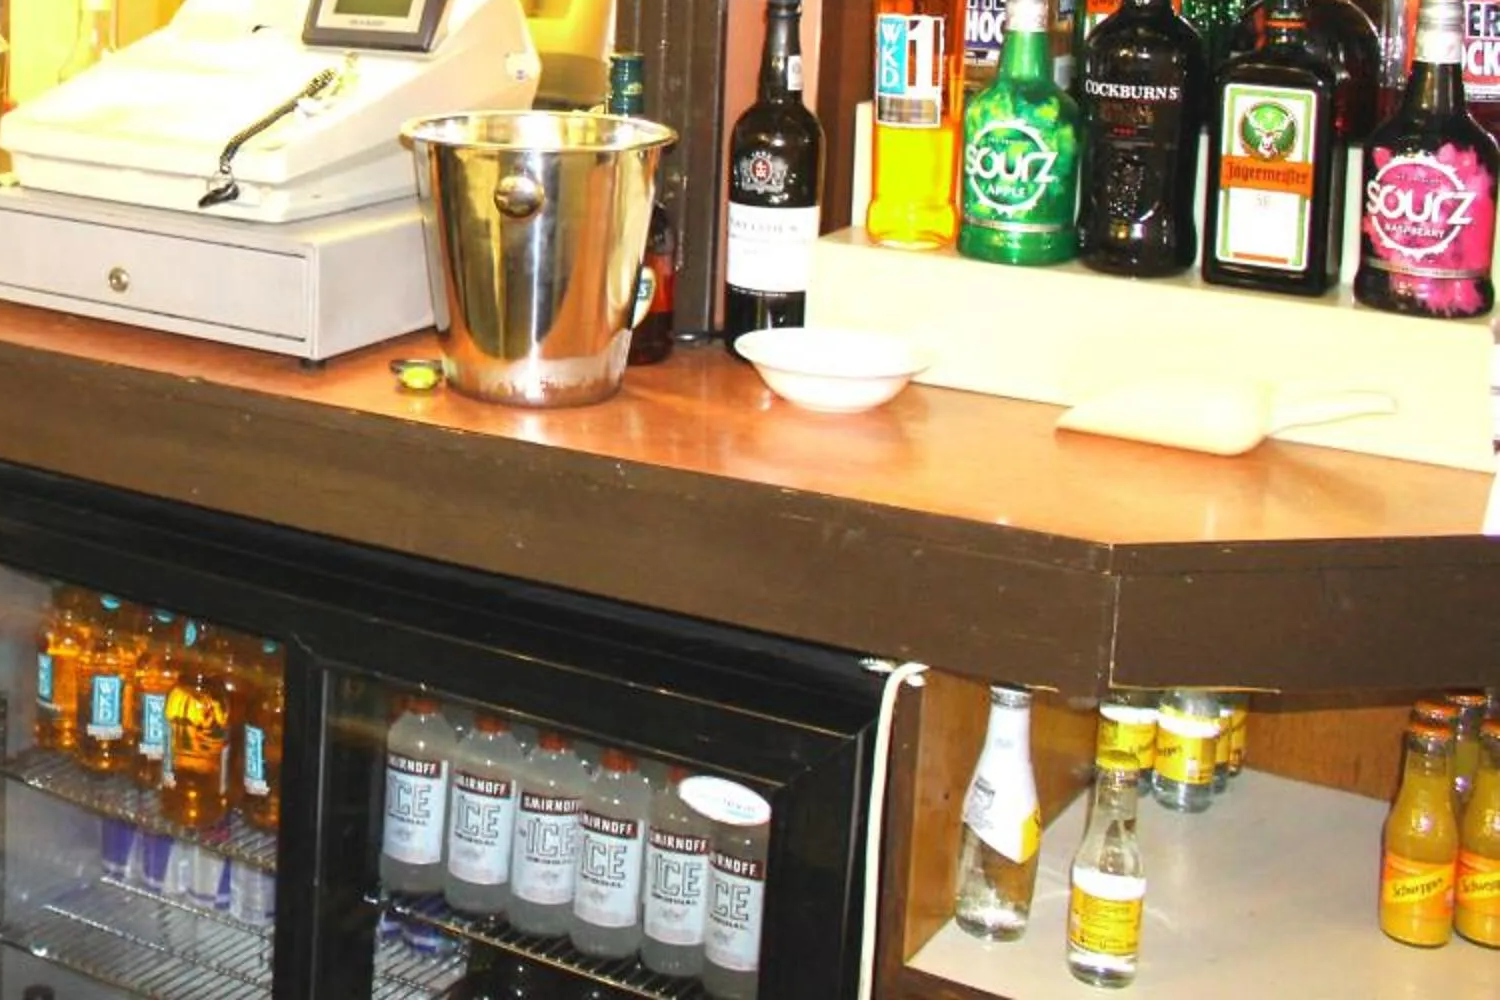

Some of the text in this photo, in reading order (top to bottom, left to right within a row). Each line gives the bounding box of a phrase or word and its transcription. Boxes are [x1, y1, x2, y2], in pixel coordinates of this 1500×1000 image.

[965, 10, 1006, 44] HOC
[880, 22, 901, 88] WKD
[1226, 158, 1309, 185] Jägermeister
[387, 772, 432, 819] ICE
[454, 795, 501, 839] ICE
[523, 796, 578, 813] SMIRNOF
[525, 817, 577, 857] ICE
[581, 835, 628, 881] ICE
[651, 853, 702, 898] ICE
[714, 879, 751, 921] CE
